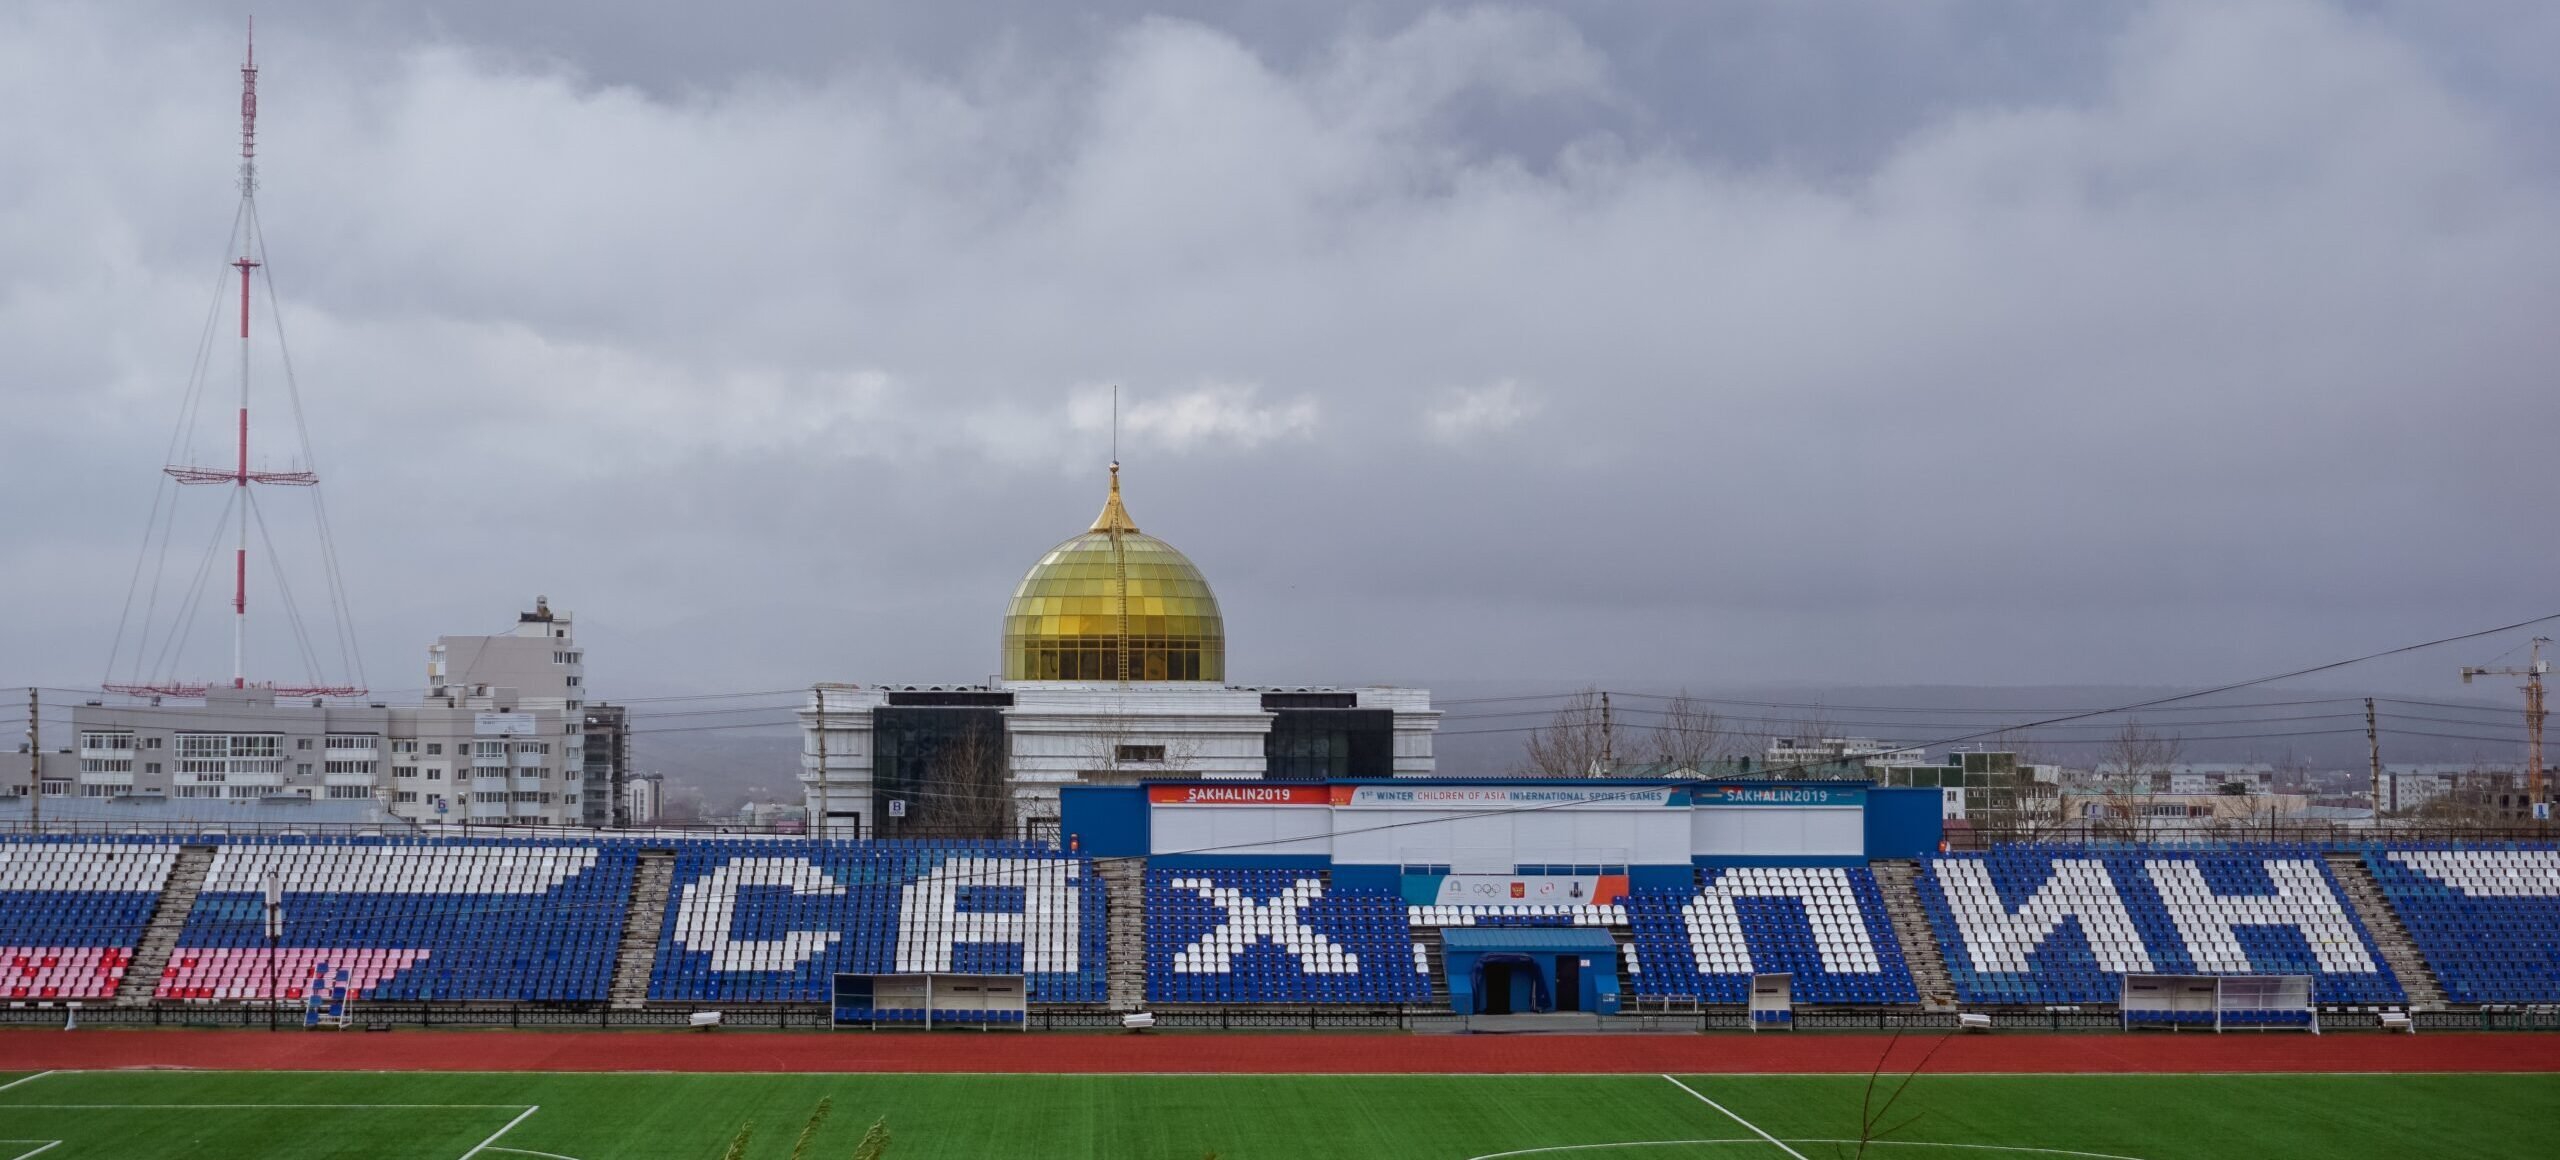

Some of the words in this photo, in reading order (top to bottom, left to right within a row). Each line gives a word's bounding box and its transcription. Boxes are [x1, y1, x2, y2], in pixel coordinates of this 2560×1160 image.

[1188, 788, 1291, 801] SAKHALIN2019
[1376, 791, 1414, 800] WINTER
[1417, 791, 1465, 800] CHILDREN
[1468, 791, 1481, 800] OF
[1484, 791, 1506, 800] ASIA
[1509, 791, 1586, 800] INTERNATIONAL
[1588, 791, 1626, 800] SPORTS
[1629, 791, 1662, 800] GAMES
[1727, 790, 1828, 802] SAKHALIN2019
